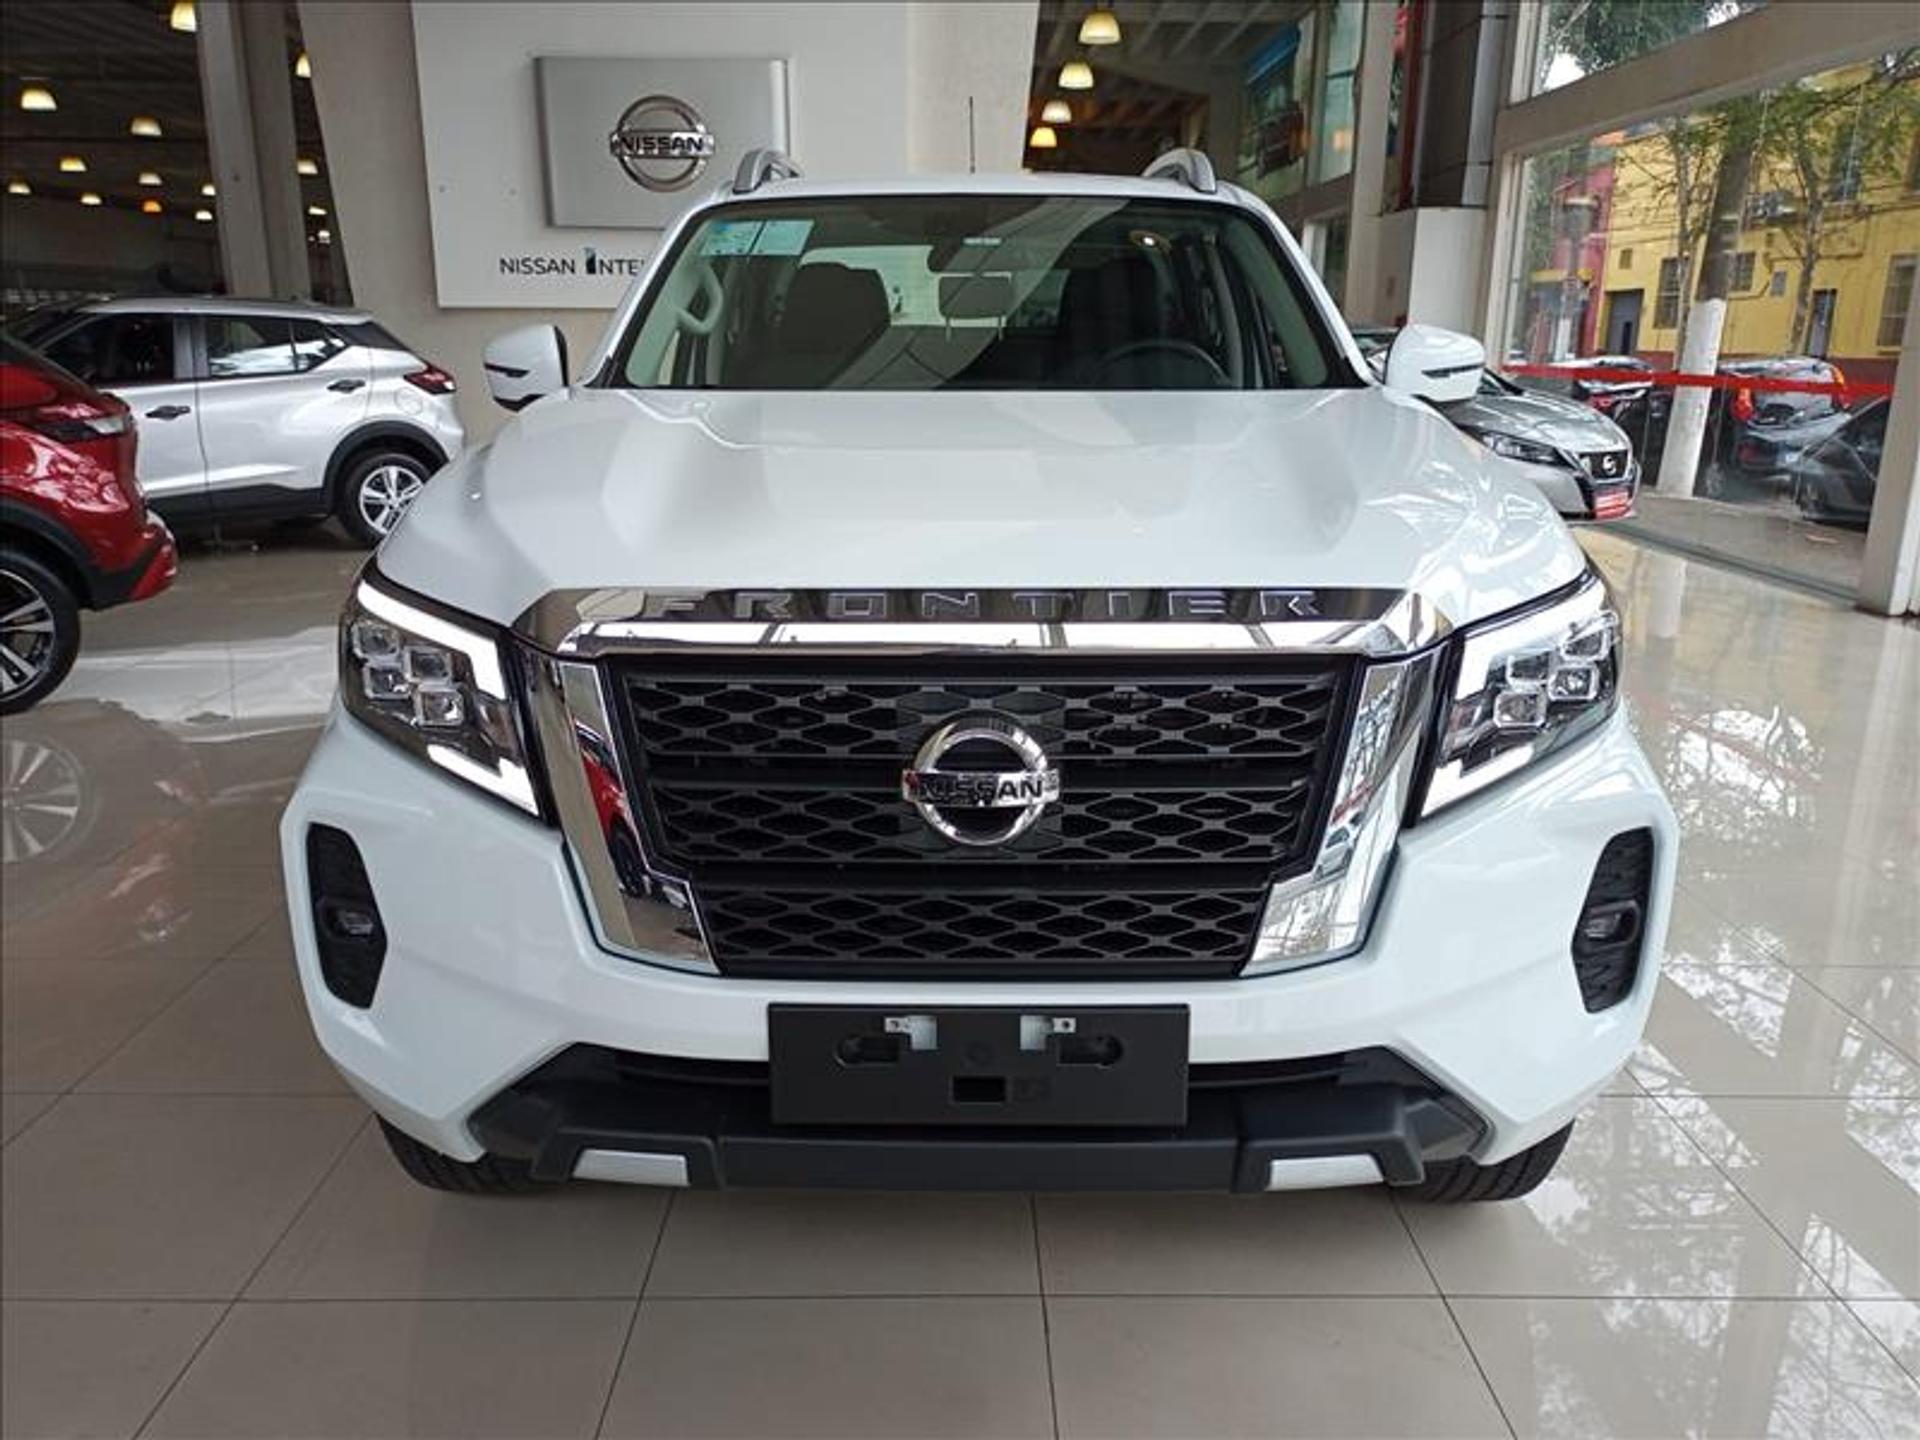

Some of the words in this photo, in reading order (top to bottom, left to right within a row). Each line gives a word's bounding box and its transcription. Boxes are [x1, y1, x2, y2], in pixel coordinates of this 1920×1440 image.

[621, 135, 704, 152] NISSAN
[500, 258, 576, 275] NISSAN
[640, 589, 1321, 620] FRONTIER
[917, 777, 1043, 800] NISSAN
